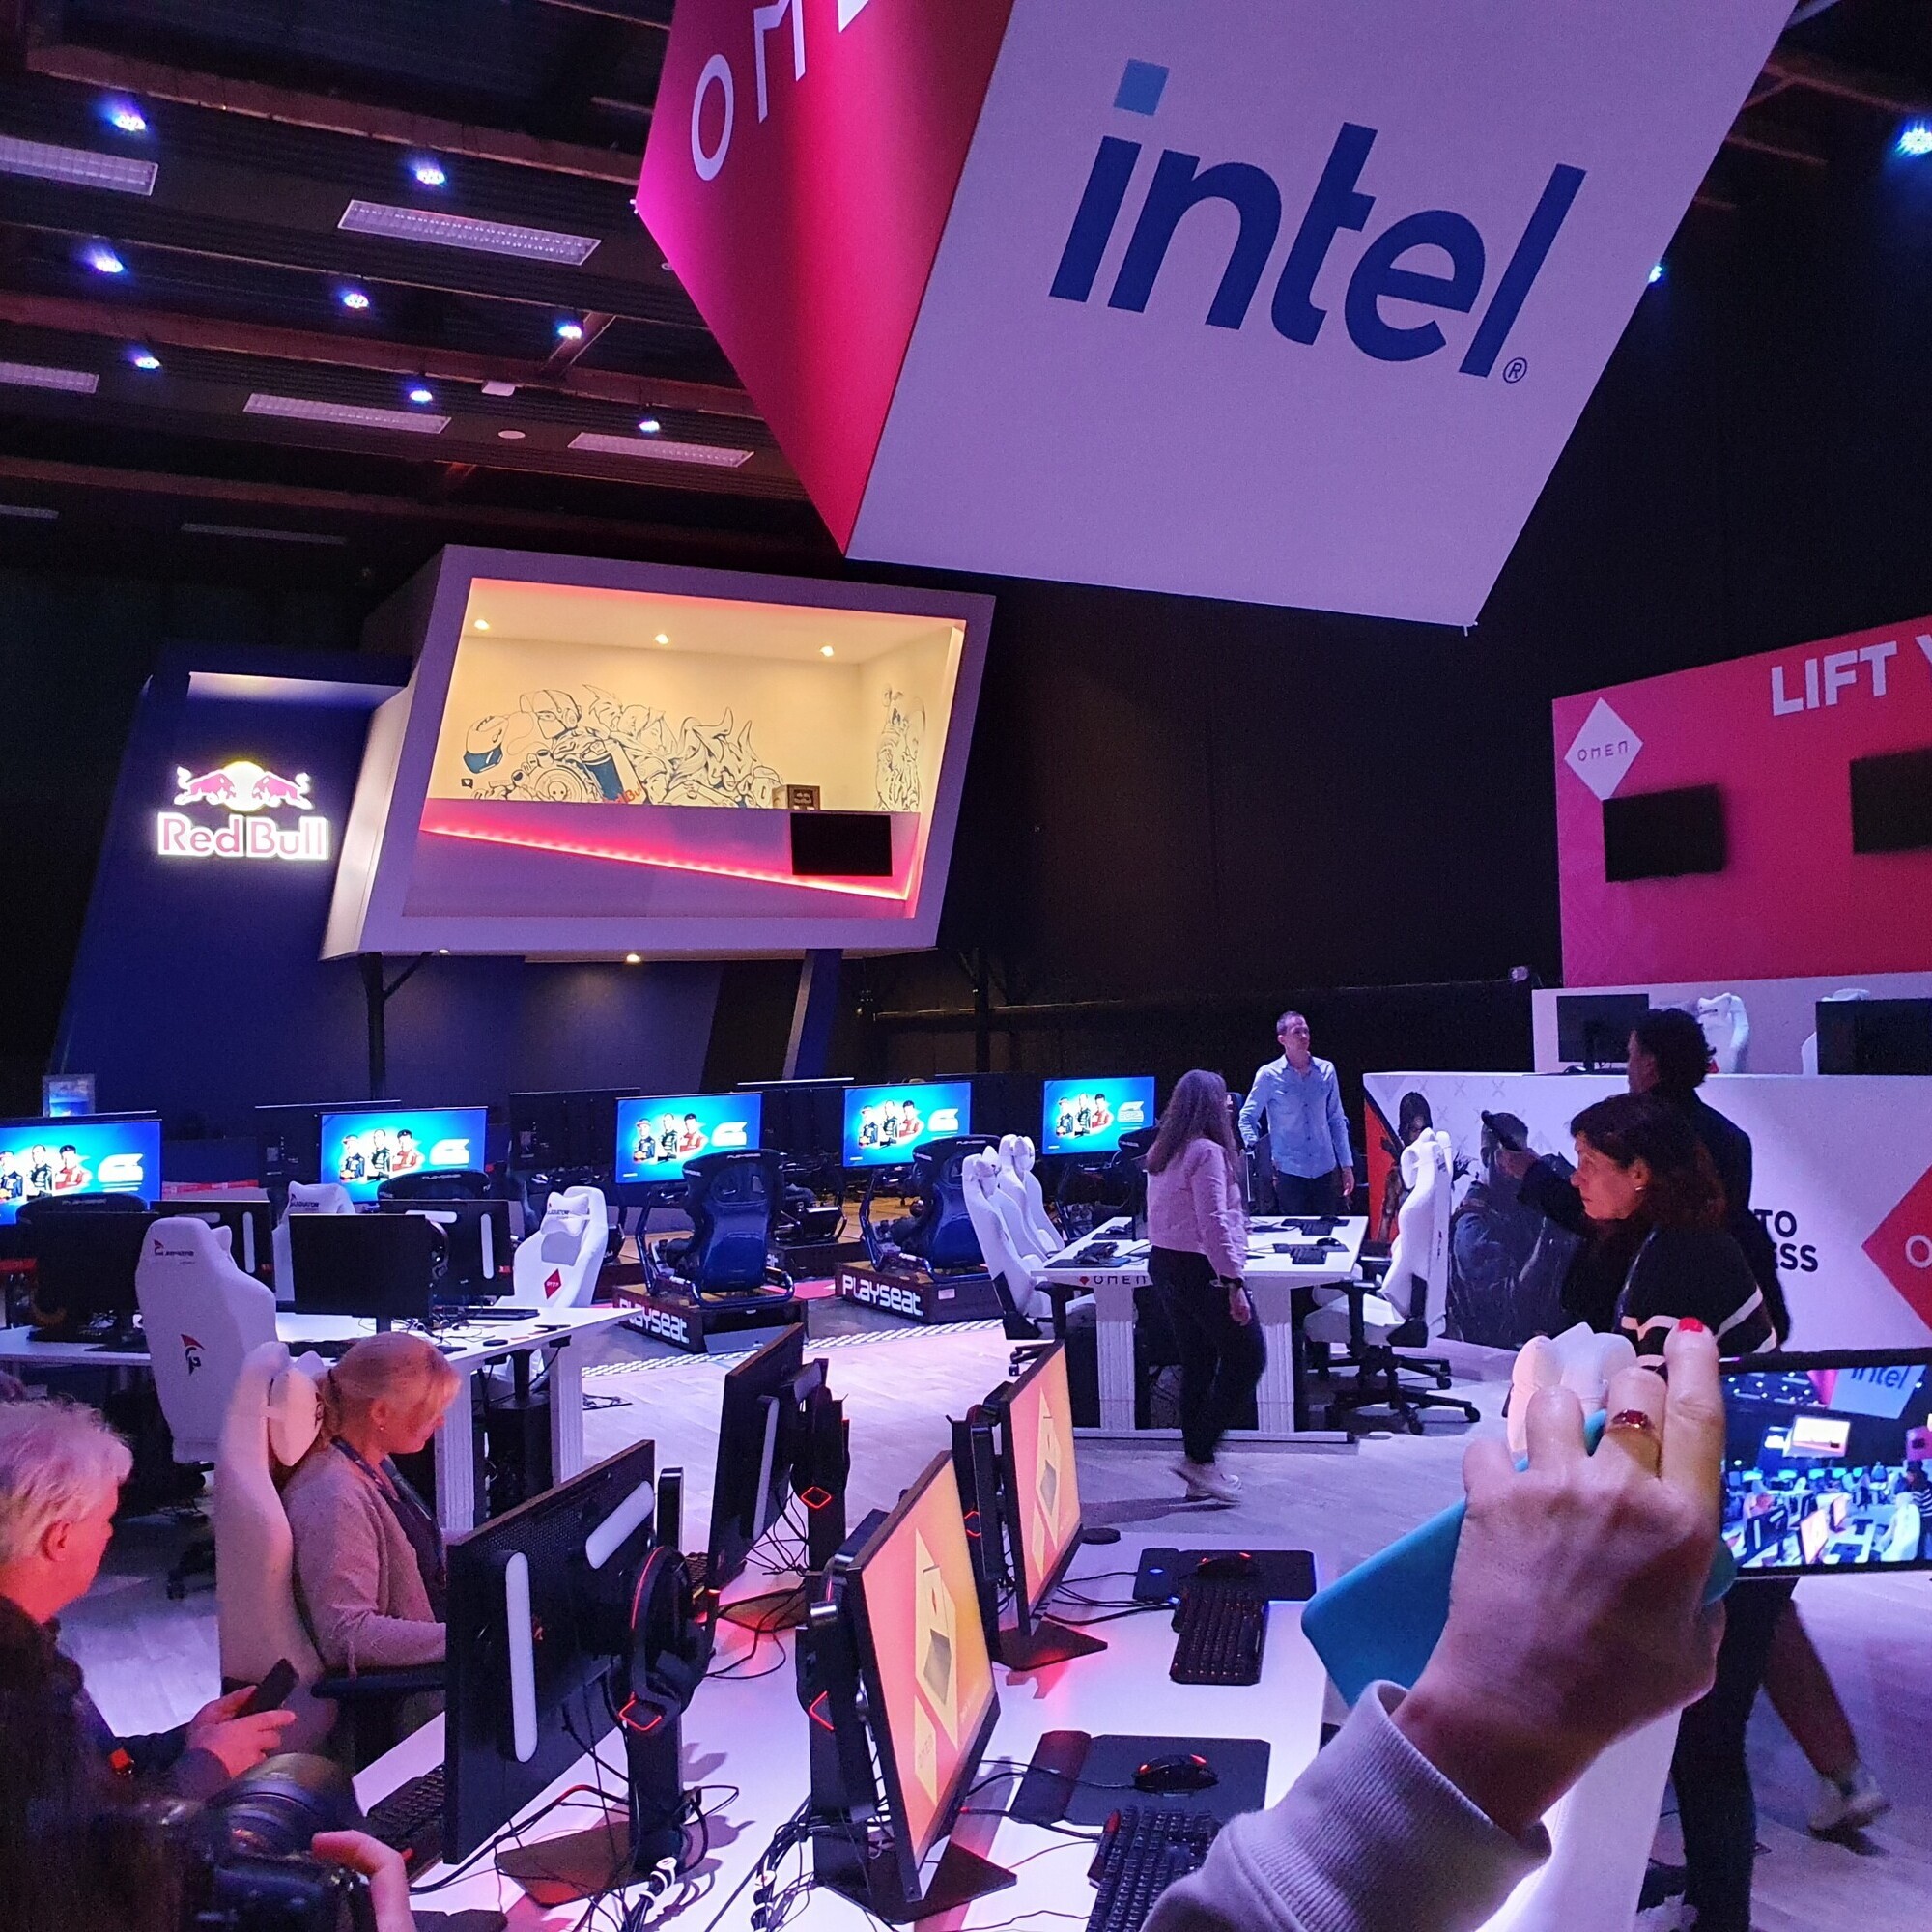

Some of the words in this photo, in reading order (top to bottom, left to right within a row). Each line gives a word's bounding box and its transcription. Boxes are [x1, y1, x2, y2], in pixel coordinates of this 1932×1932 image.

[691, 0, 869, 182] OM
[1049, 58, 1587, 378] intel
[1772, 640, 1898, 716] LIFT
[1577, 740, 1628, 761] OMEN
[161, 816, 242, 854] Red
[248, 819, 326, 857] Bull
[1753, 1208, 1798, 1237] TO
[1775, 1242, 1818, 1272] SS
[1094, 1275, 1147, 1285] OMEN
